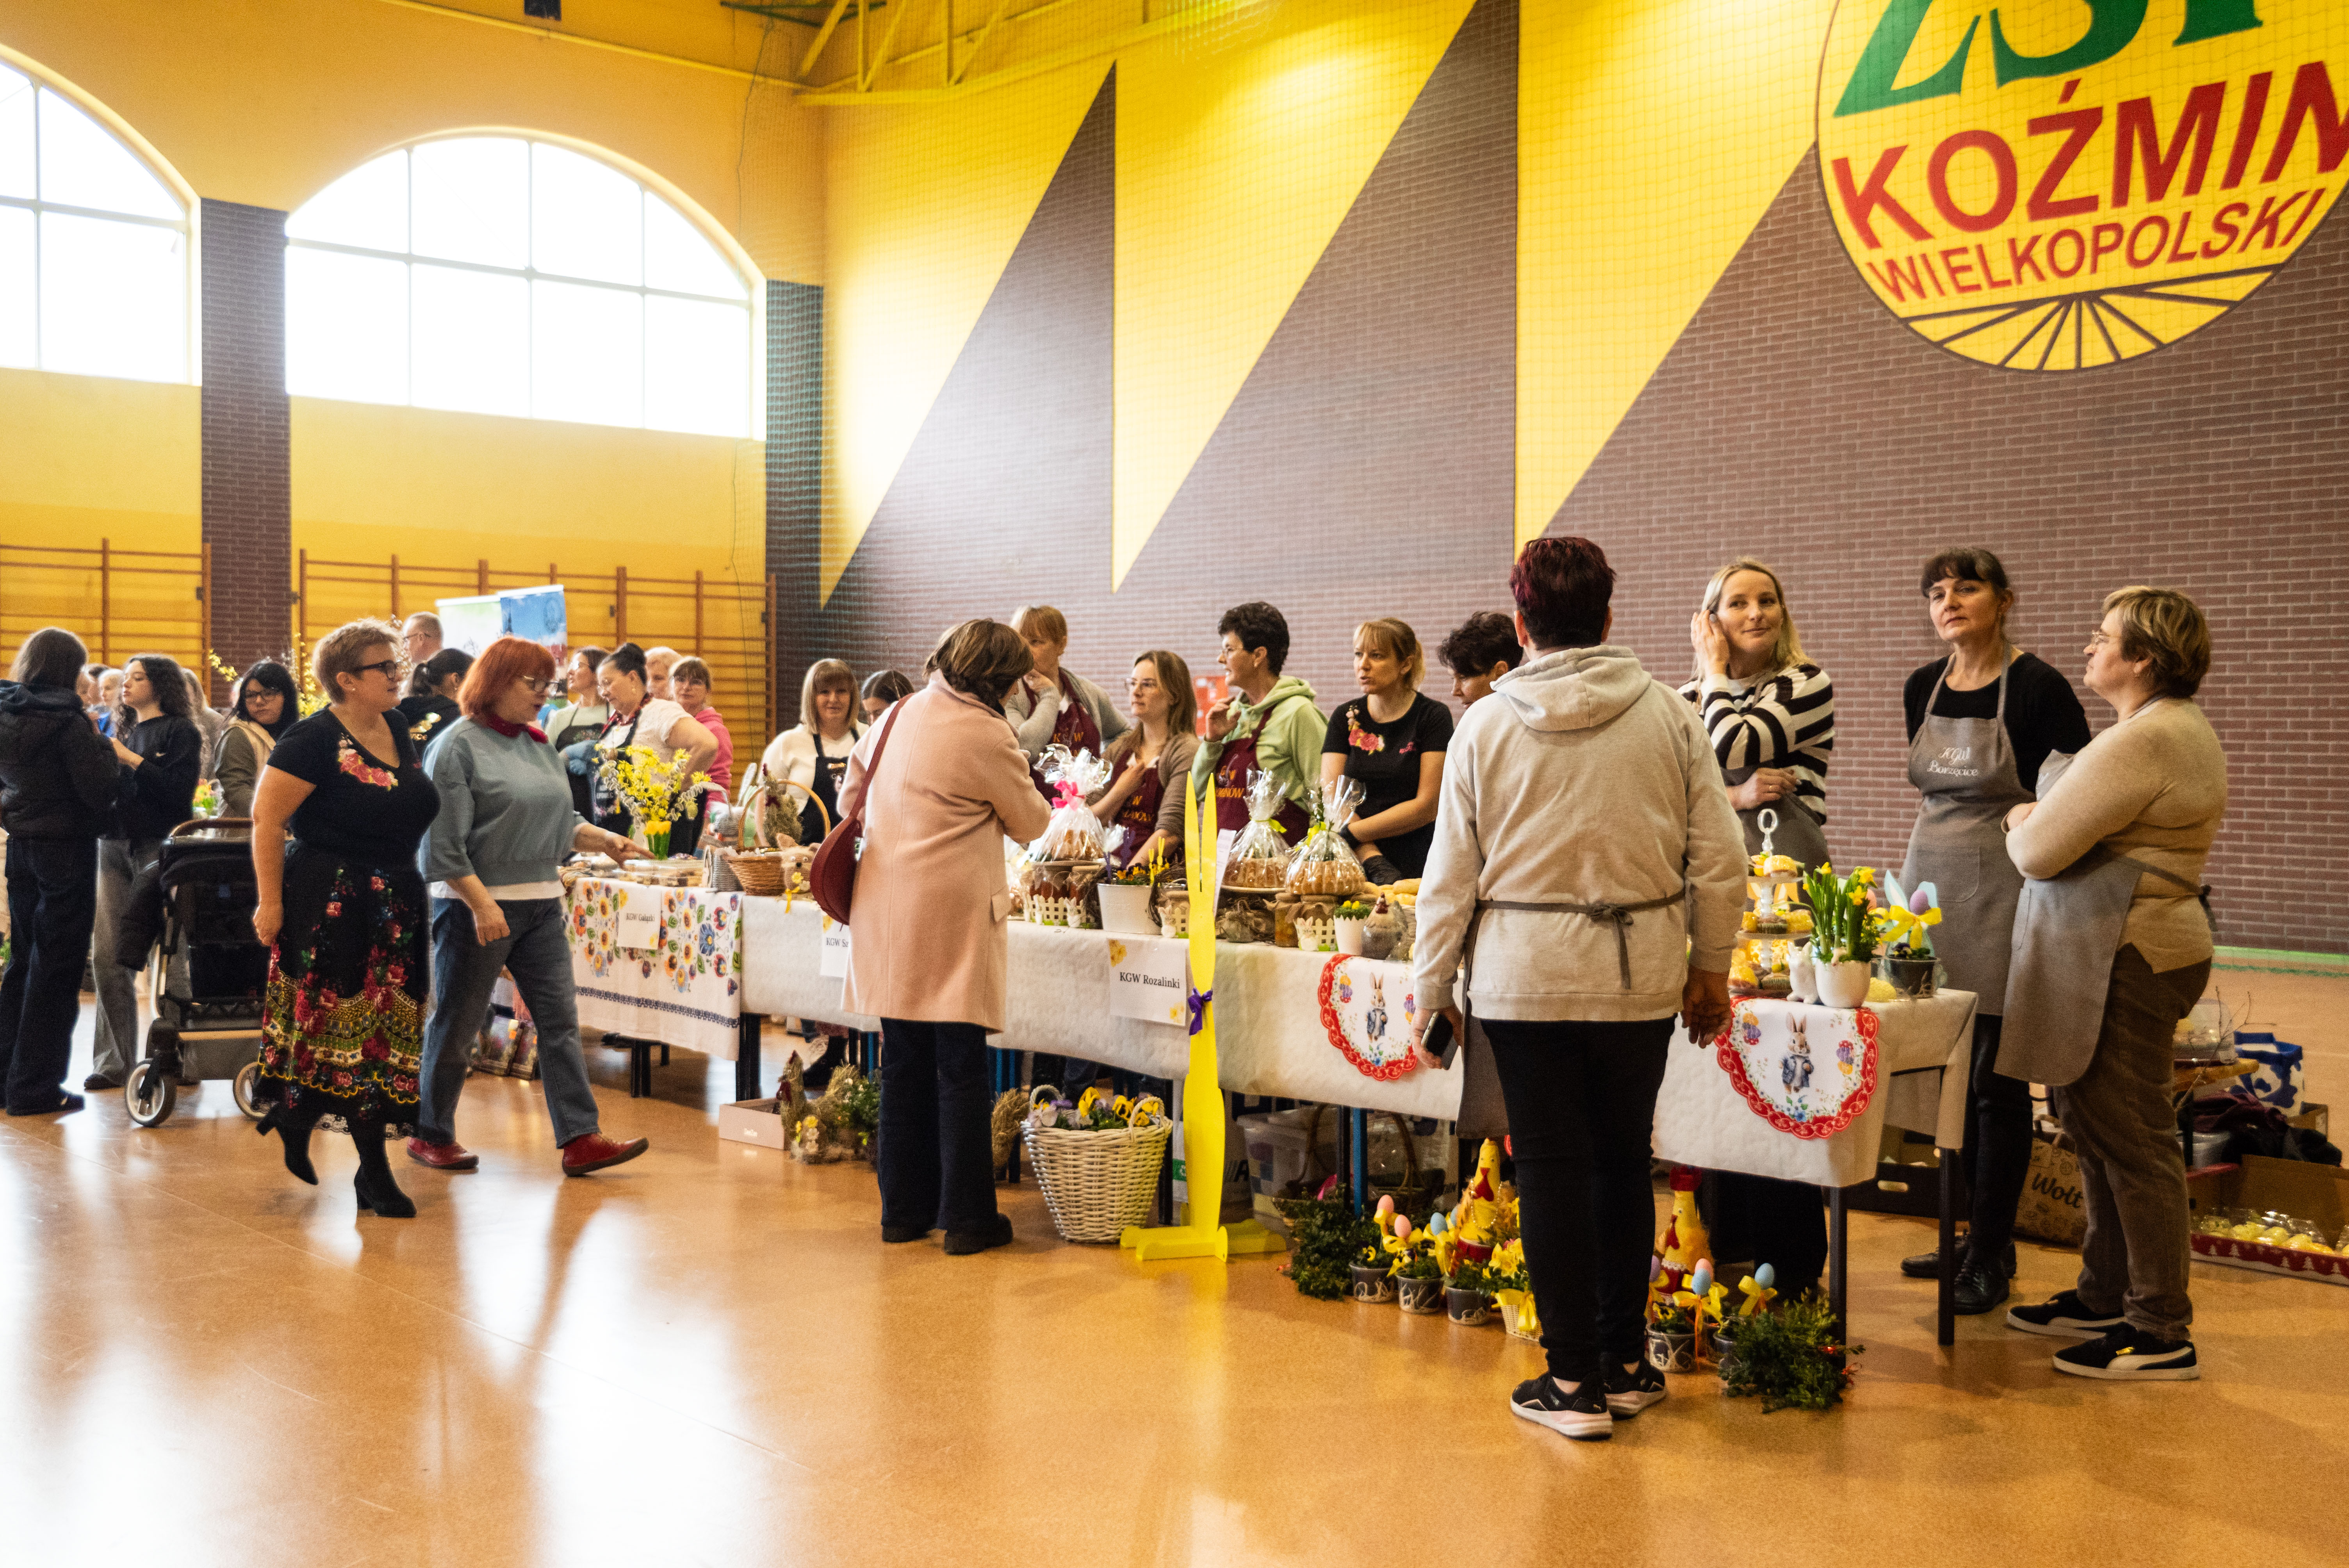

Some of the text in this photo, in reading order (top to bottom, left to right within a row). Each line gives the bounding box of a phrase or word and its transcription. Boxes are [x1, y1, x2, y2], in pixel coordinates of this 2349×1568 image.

[1831, 60, 2349, 250] KOŹMIN
[1866, 187, 2326, 303] WIELKOPOLSKI
[1927, 760, 1979, 777] Borzęcice
[826, 937, 841, 946] KGW
[1119, 971, 1180, 989] KGW Rozalinki
[2032, 1172, 2084, 1208] Wolt
